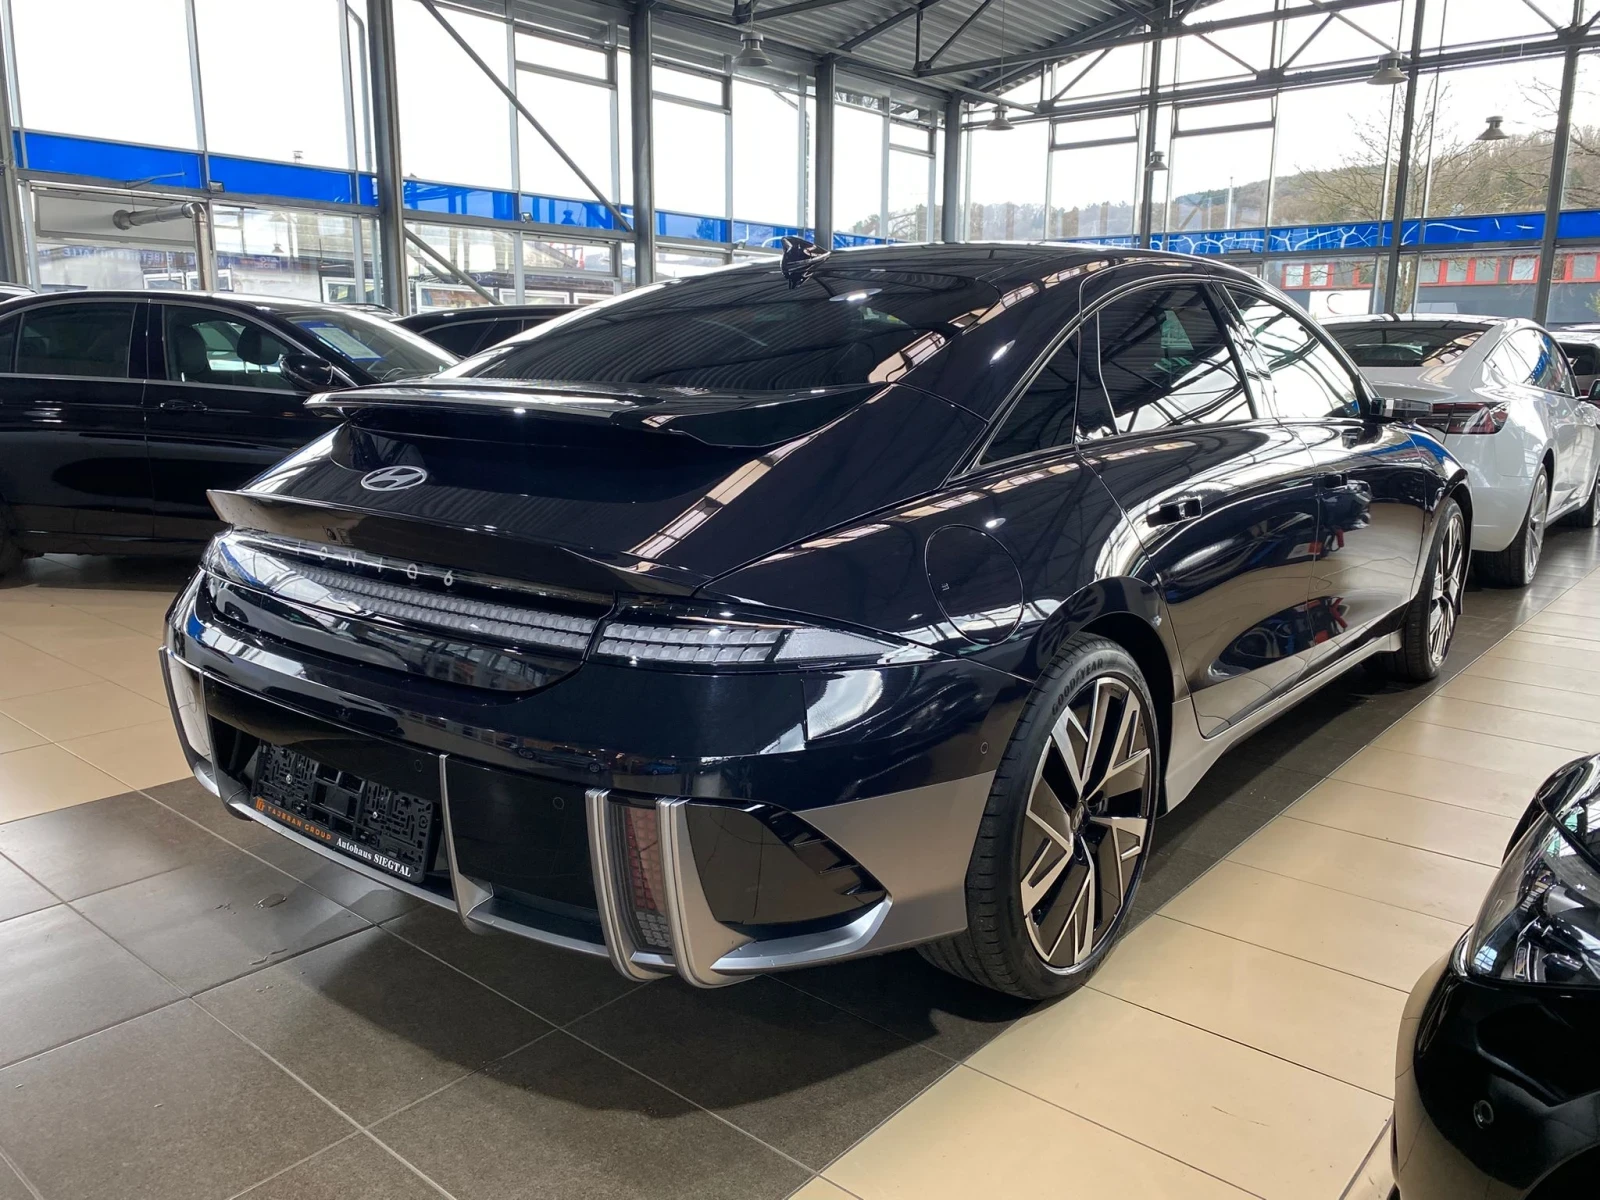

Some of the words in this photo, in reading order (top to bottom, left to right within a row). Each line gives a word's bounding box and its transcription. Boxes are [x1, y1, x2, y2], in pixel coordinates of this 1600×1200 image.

[297, 541, 419, 580] IONIQ
[443, 570, 454, 587] 6
[1051, 658, 1104, 716] GOODYEAR
[304, 824, 332, 841] GROUP
[336, 838, 372, 860] Autohaus
[373, 853, 411, 877] SIEGTAL
